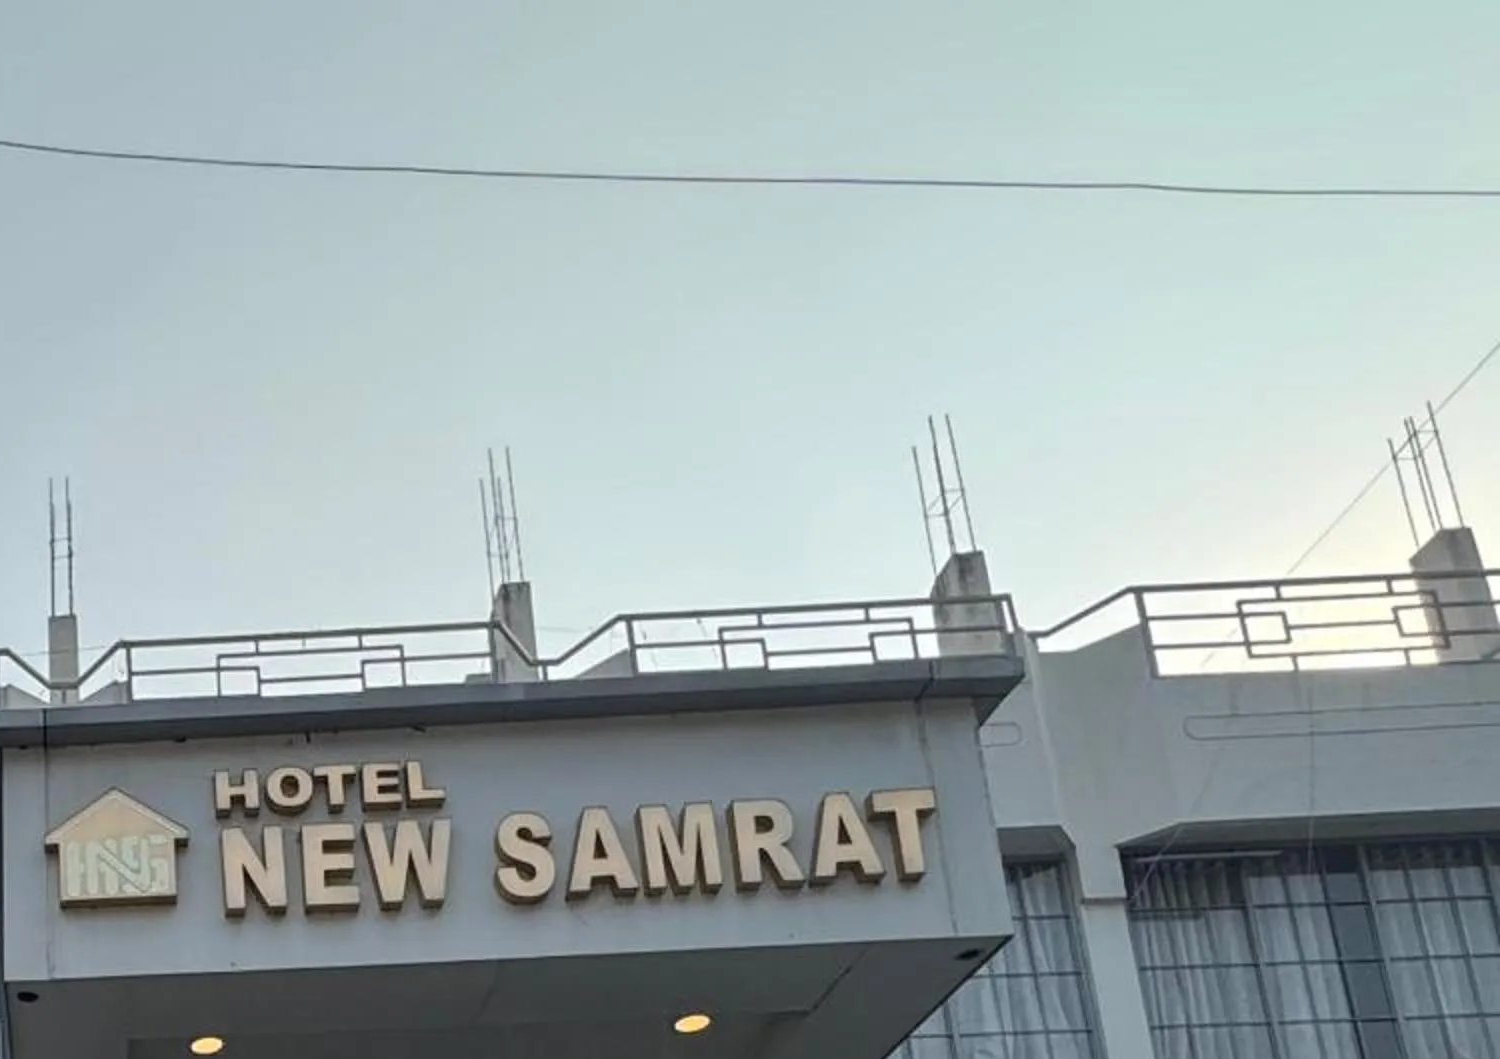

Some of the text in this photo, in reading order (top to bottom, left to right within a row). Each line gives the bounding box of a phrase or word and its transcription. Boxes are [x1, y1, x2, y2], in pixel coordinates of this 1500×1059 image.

[214, 760, 447, 818] HOTEL
[221, 788, 936, 918] NEW SAMRAT
